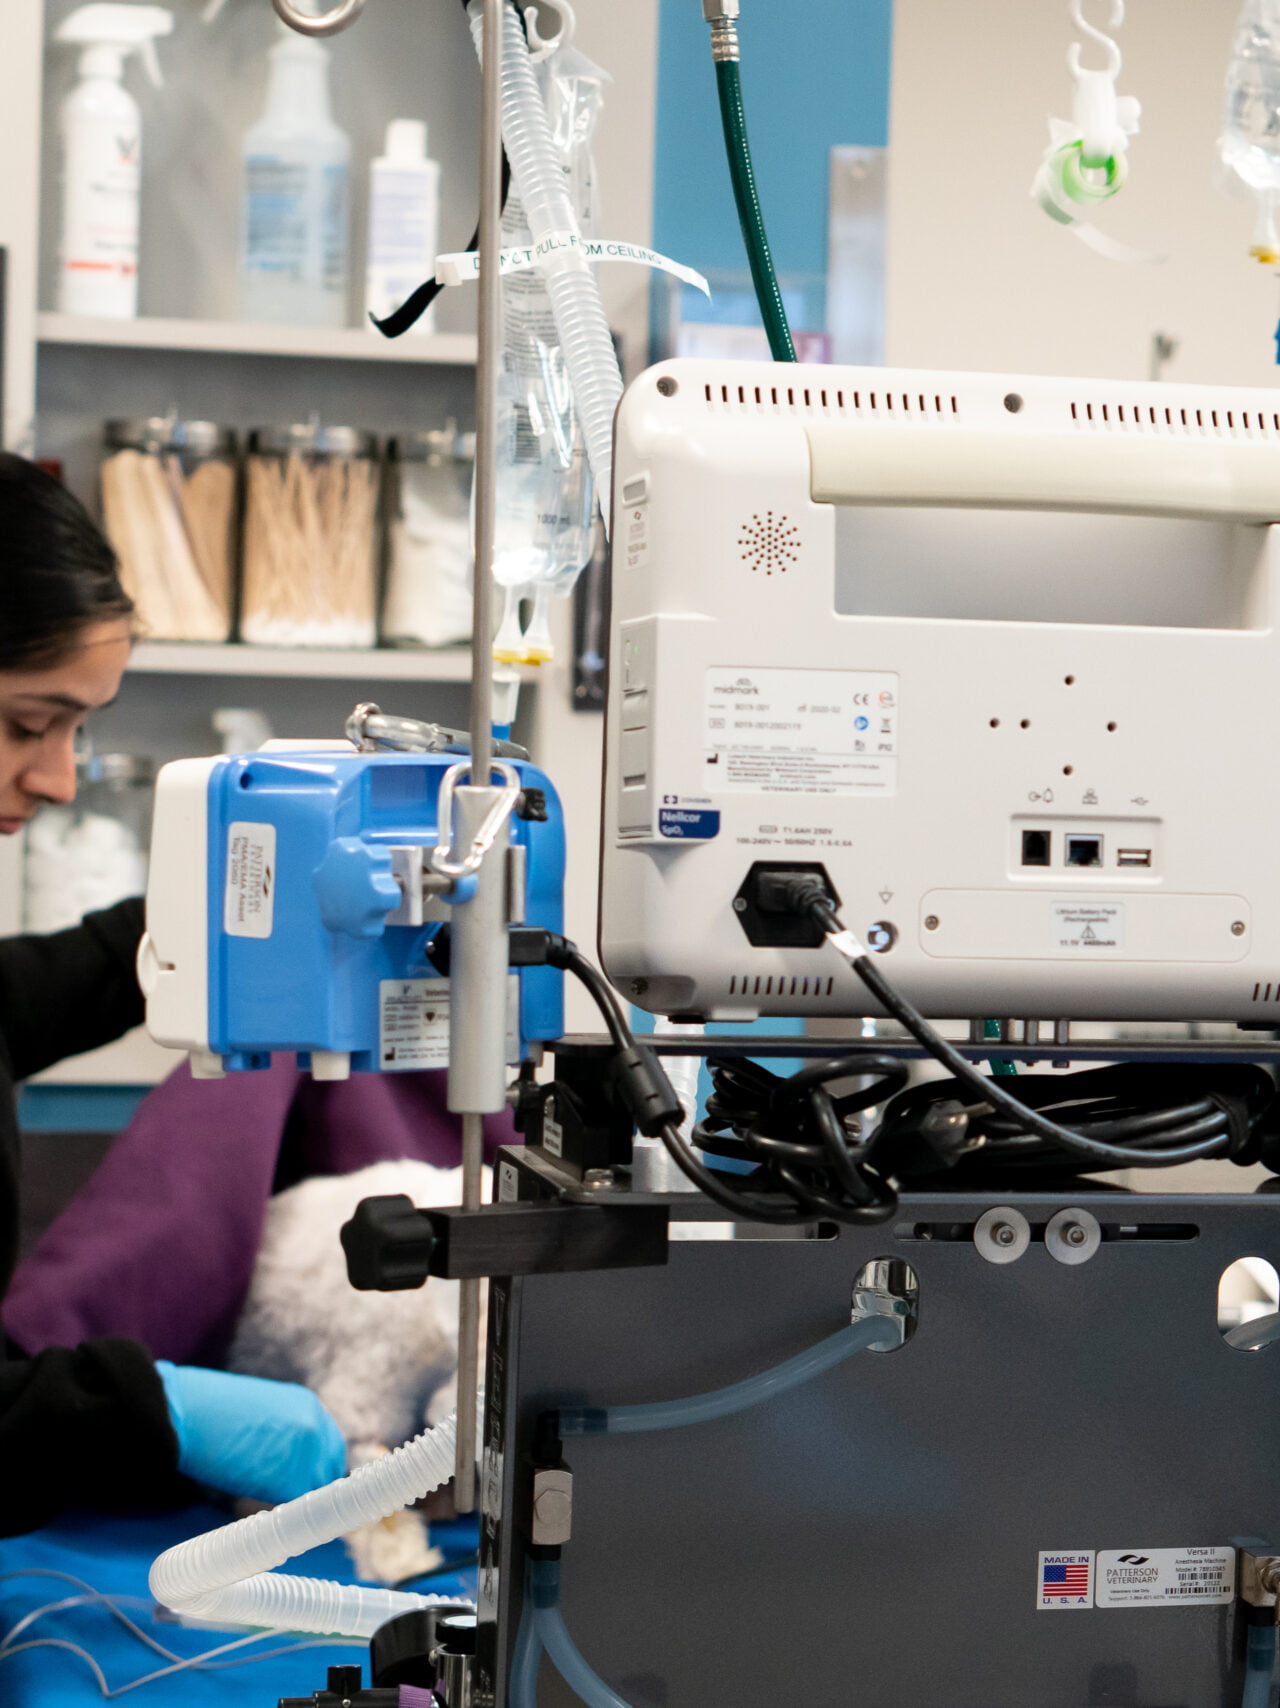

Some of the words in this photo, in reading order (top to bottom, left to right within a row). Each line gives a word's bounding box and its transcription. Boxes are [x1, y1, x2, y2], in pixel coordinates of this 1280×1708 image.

[607, 244, 663, 264] CEILING
[713, 685, 759, 695] midmark
[661, 811, 701, 824] Nellcor
[736, 837, 771, 845] 100-240V
[255, 845, 263, 913] PATTERSON
[1079, 908, 1100, 917] Battery
[1187, 1548, 1208, 1556] Versa
[1044, 1556, 1074, 1564] MADE
[1174, 1558, 1203, 1566] Anesthesia
[1203, 1557, 1227, 1565] Machine
[1106, 1568, 1159, 1578] PATTERSON
[1106, 1576, 1159, 1585] VETERINARY
